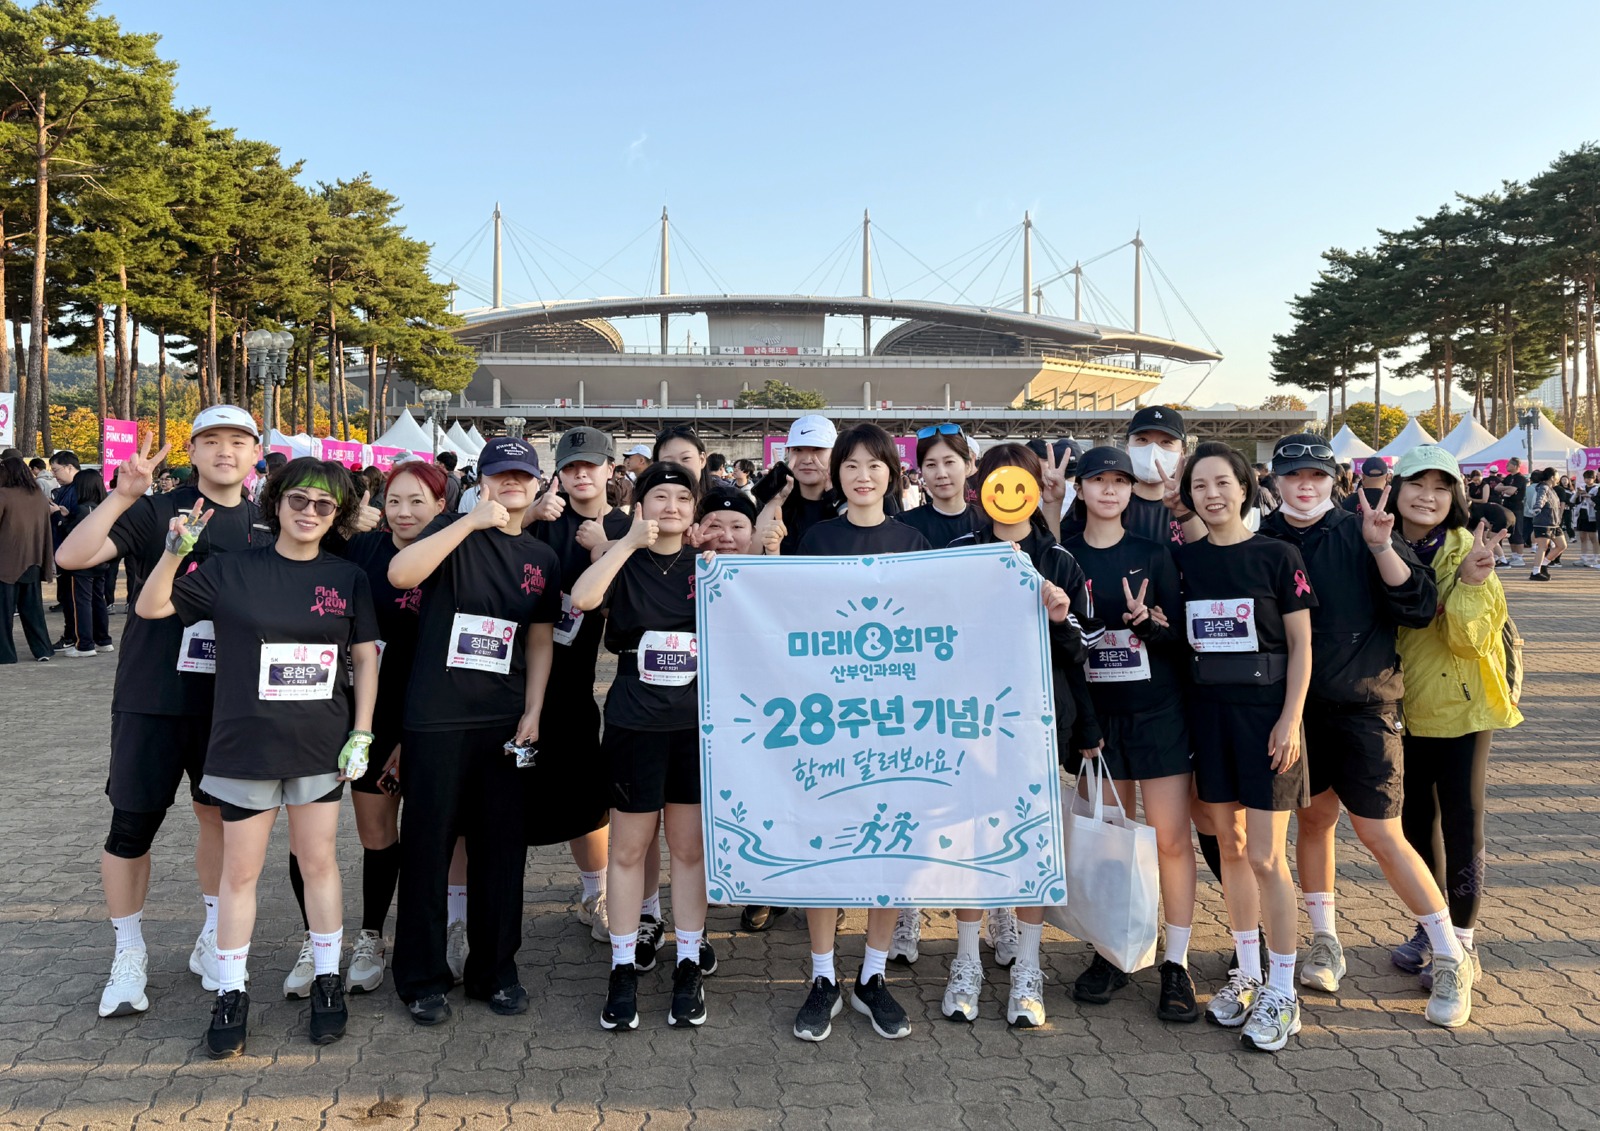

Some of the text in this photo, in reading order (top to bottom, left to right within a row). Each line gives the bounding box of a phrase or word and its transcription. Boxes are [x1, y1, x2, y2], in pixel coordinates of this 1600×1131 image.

[106, 432, 133, 443] PINK RUN
[106, 449, 114, 458] 5K
[324, 596, 347, 610] RUN
[1204, 620, 1235, 633] 김수랑
[471, 636, 500, 652] 정다윤
[787, 621, 958, 662] 미래&희망
[656, 653, 687, 666] 김민지
[1098, 650, 1129, 662] 최은진
[282, 666, 317, 679] 윤현우
[829, 662, 917, 684] 산부인과의원
[762, 692, 995, 750] 28주년 기념!
[791, 746, 965, 792] 함께 달려보아요!
